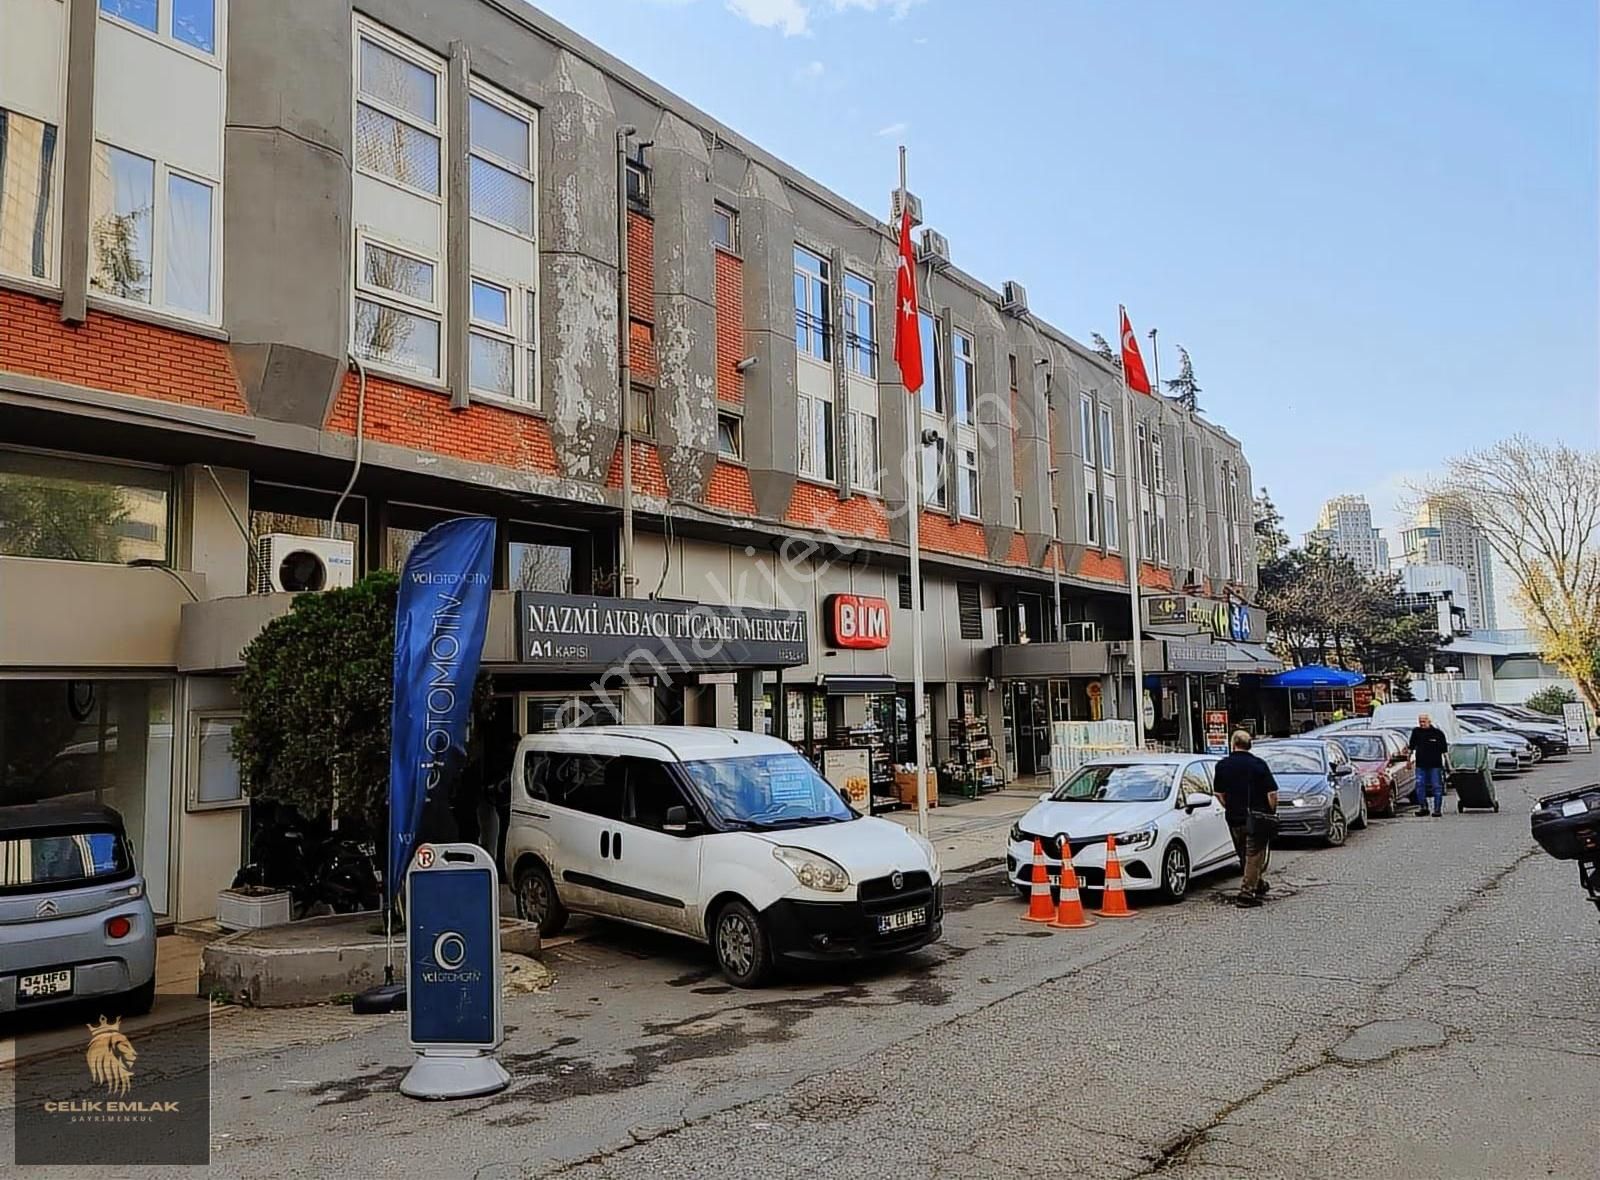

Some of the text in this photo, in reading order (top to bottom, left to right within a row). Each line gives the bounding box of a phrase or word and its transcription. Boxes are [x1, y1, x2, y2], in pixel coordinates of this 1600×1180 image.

[528, 602, 805, 642] NAZMİ AKBACI TİCARET MERKEZİ
[840, 598, 886, 638] BİM
[530, 640, 588, 658] A1 KAPISI
